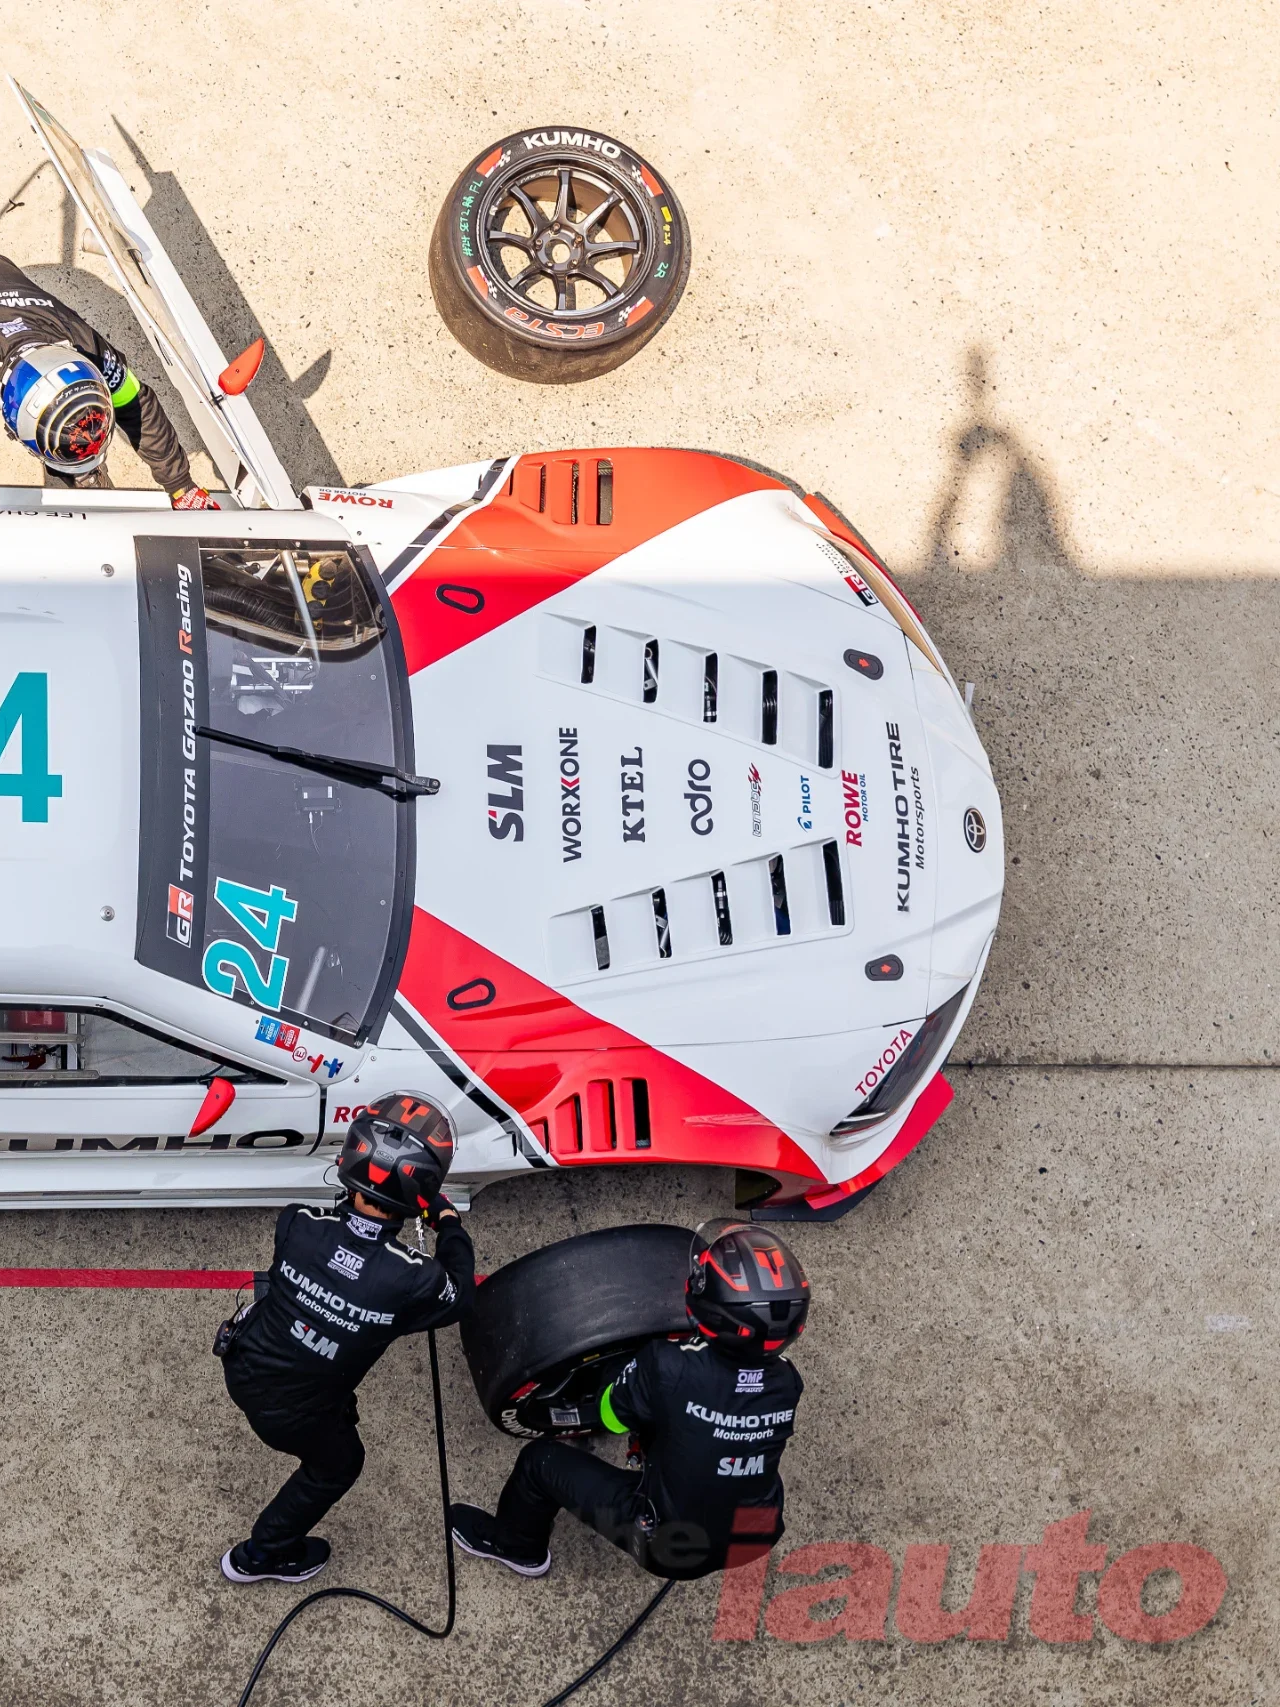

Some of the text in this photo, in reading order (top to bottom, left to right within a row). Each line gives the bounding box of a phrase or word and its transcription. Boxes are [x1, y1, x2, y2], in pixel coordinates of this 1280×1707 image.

[522, 131, 622, 159] KUMHO
[318, 493, 394, 509] ROWE
[176, 563, 196, 945] GR TOYOTA GAZOO Racing
[486, 743, 524, 842] SLM
[621, 746, 646, 843] KTEL
[800, 775, 811, 814] PILOT
[841, 770, 863, 847] ROWE
[860, 790, 869, 822] MOTOR
[910, 766, 927, 870] Motorsports
[202, 876, 298, 1012] 24
[855, 1028, 913, 1098] TOYOTA
[333, 1250, 364, 1270] OMP
[296, 1291, 360, 1333] Motorsports
[290, 1319, 339, 1360] SLM
[737, 1371, 764, 1383] OMP
[713, 1428, 774, 1442] Motorsports
[717, 1454, 764, 1476] SLM
